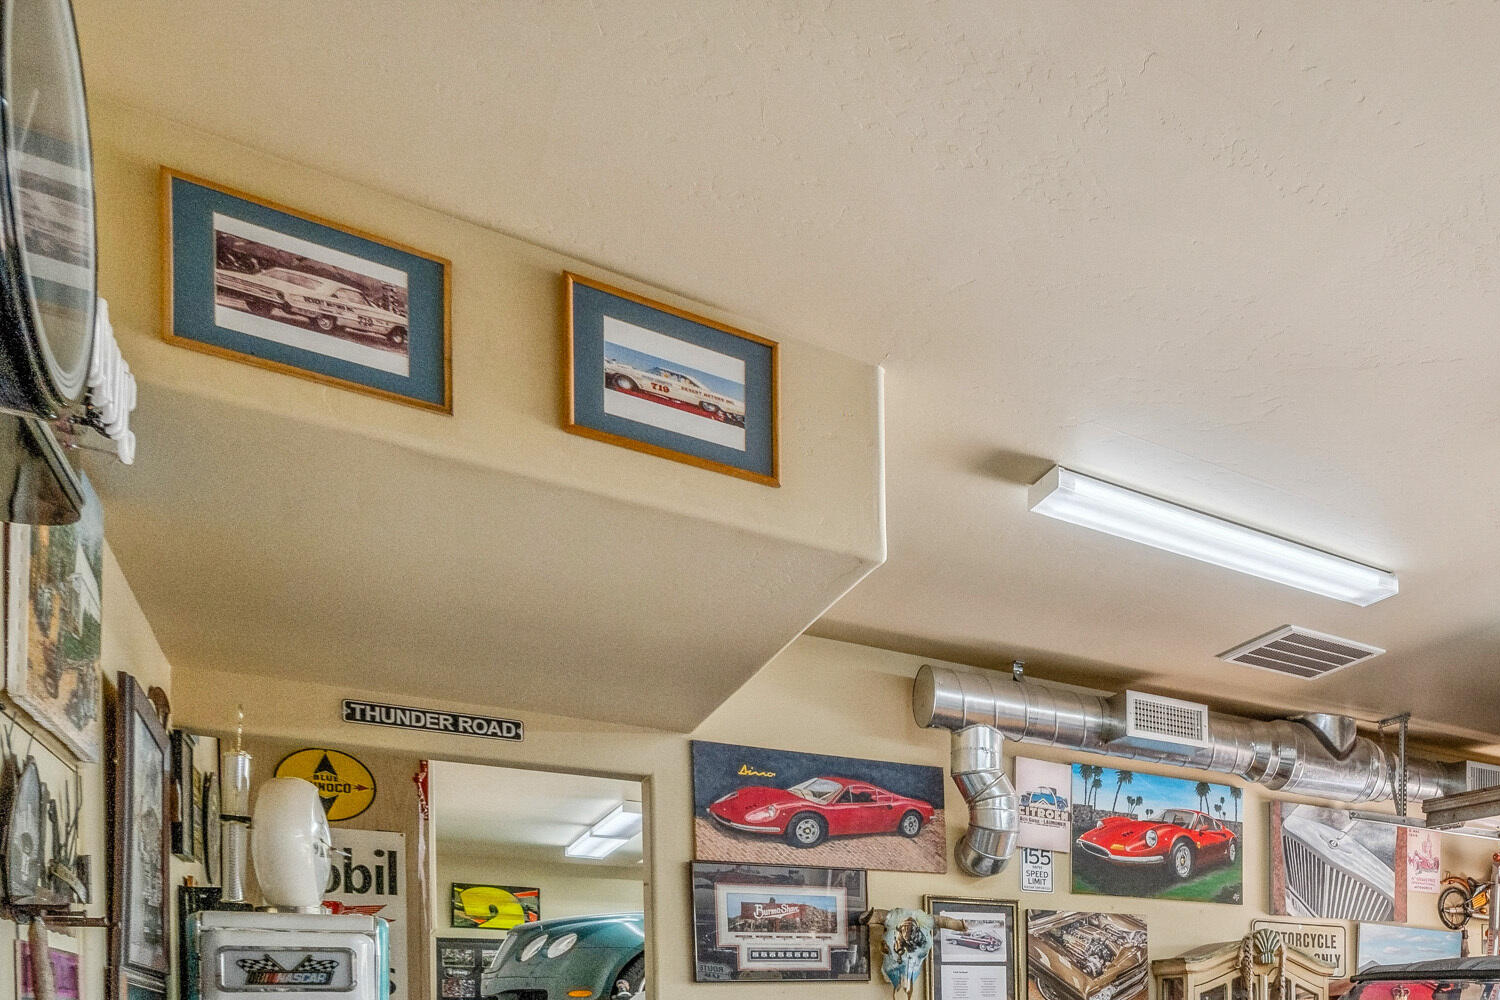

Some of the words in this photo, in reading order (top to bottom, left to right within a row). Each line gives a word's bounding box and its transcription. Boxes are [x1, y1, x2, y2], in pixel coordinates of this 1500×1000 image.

[646, 382, 671, 393] 719
[350, 703, 455, 731] THUNDER
[458, 716, 517, 738] ROAD
[313, 774, 339, 782] BLUE
[310, 779, 352, 794] NOCO
[1023, 847, 1051, 866] 155
[326, 847, 398, 896] obil
[1026, 870, 1049, 878] SPEED
[1028, 878, 1047, 886] LIMIT
[1277, 931, 1337, 949] TORCYCLE
